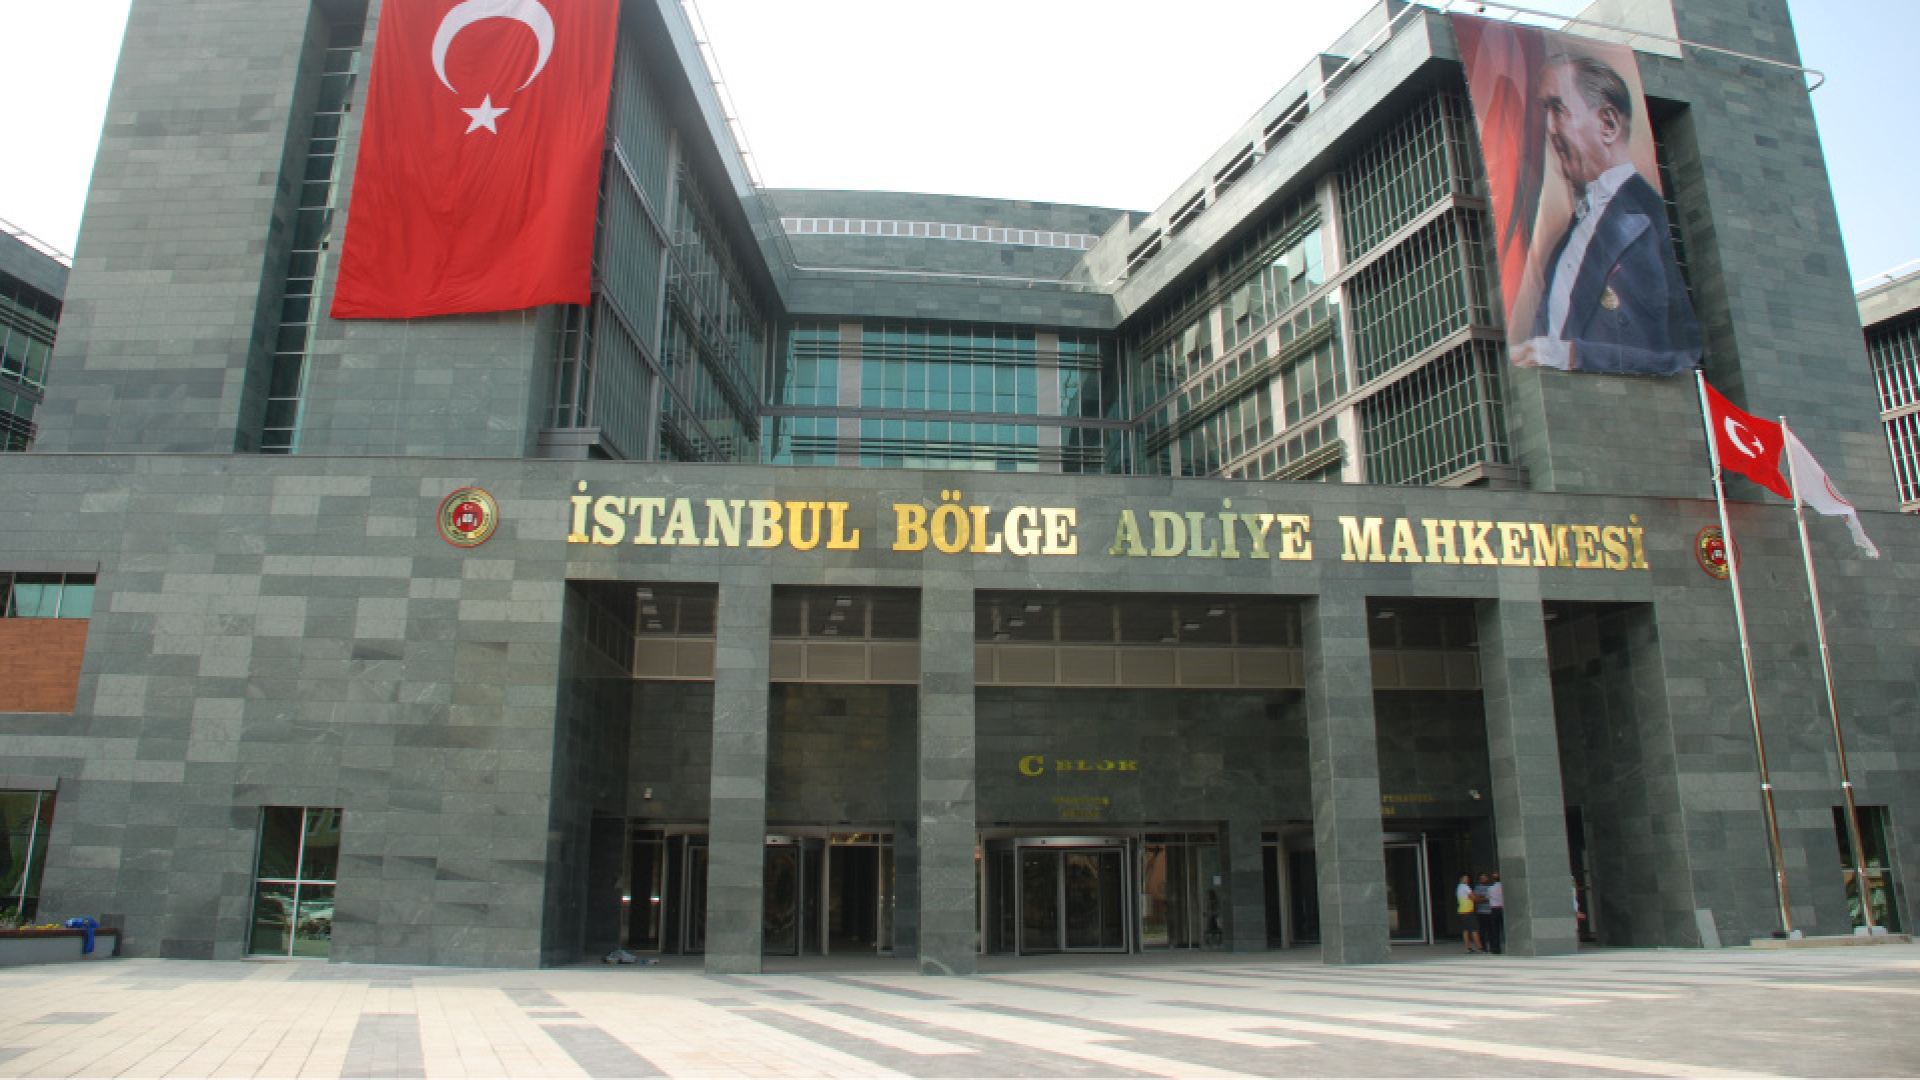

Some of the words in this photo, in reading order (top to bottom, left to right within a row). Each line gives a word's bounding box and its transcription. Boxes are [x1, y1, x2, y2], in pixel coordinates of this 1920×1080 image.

[567, 480, 860, 551] İSTANBUL
[892, 490, 1078, 556] BÖLGE
[1109, 498, 1313, 560] ADLİYE
[1339, 514, 1649, 571] MAHKEMESİ
[1019, 755, 1044, 777] C
[1055, 759, 1138, 771] BLOK
